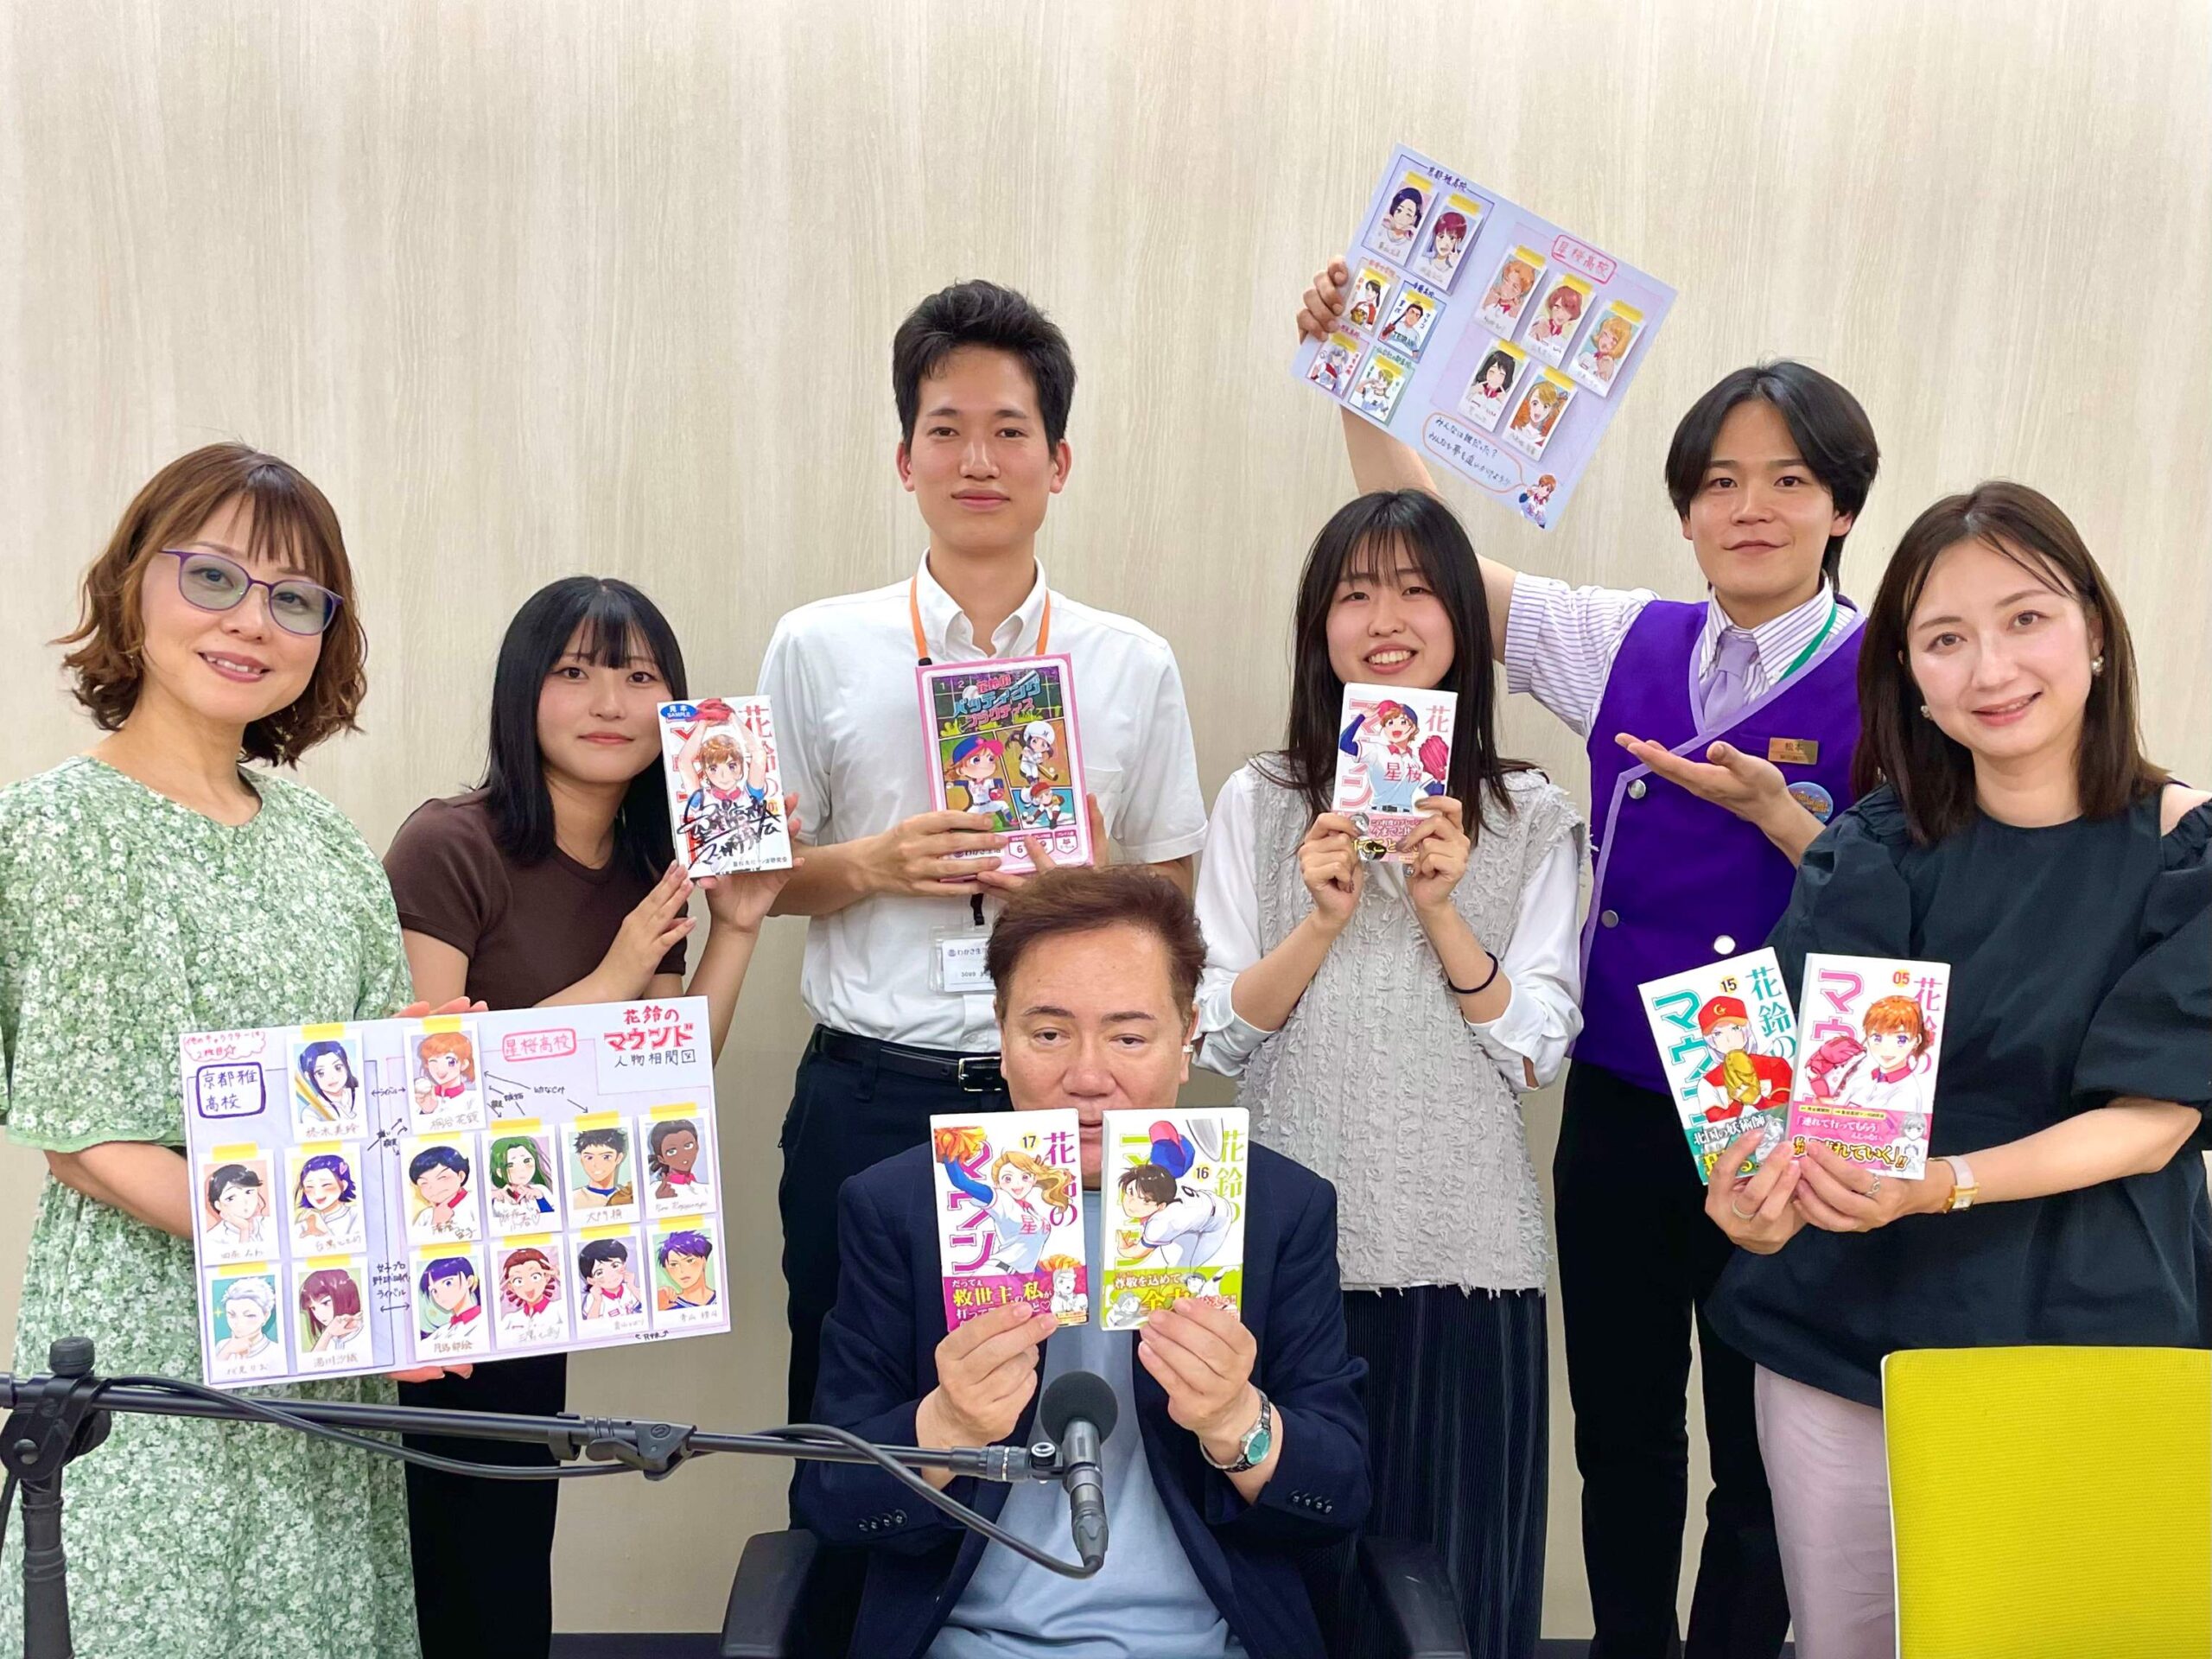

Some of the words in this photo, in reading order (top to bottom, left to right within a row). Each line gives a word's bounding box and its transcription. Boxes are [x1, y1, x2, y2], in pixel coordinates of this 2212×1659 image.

[1720, 978, 1738, 993] 15
[1892, 971, 1910, 985] 05
[623, 1004, 680, 1025] 花鈴の
[603, 1023, 695, 1052] マウンド
[201, 1069, 258, 1090] 京都雅
[205, 1093, 242, 1112] 高校
[1021, 1135, 1038, 1149] 17
[1042, 1131, 1081, 1228] 花の
[1195, 1166, 1211, 1180] 16
